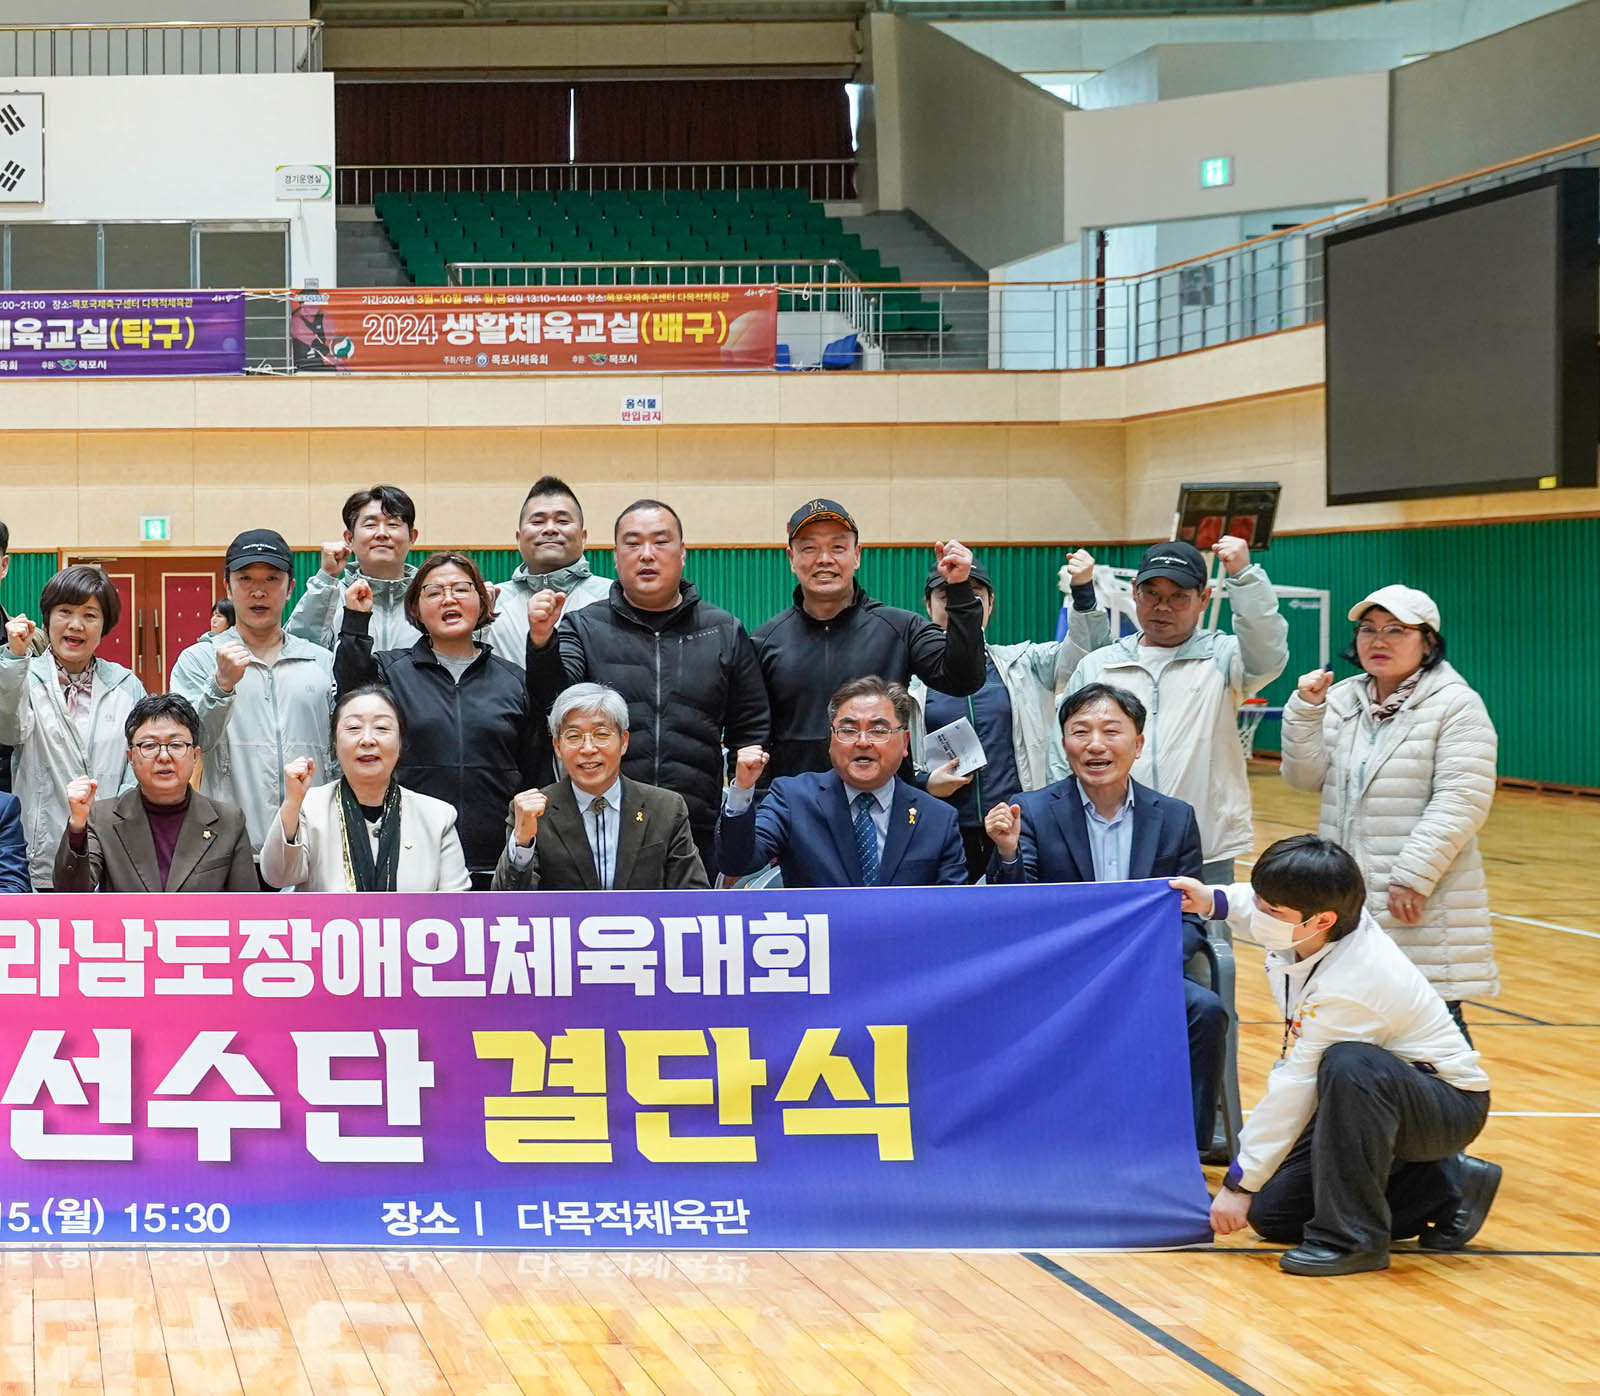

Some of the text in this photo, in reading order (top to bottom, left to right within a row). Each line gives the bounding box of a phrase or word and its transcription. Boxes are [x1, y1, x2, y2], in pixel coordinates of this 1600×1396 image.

[416, 294, 462, 305] 3월~10월
[464, 294, 482, 304] 매주
[525, 293, 583, 303] 13:10~14:40
[362, 311, 727, 346] 2024 생활체육교실(배구)
[78, 360, 107, 371] 목포시
[491, 354, 549, 365] 목포시체육회
[609, 354, 637, 365] 목포시
[621, 411, 661, 421] 반입금지
[0, 1028, 435, 1162] 선수단
[472, 1024, 914, 1163] 결단식
[124, 1202, 230, 1233] 15:30
[380, 1201, 460, 1236] 장소
[517, 1199, 750, 1236] 다목적체육관
